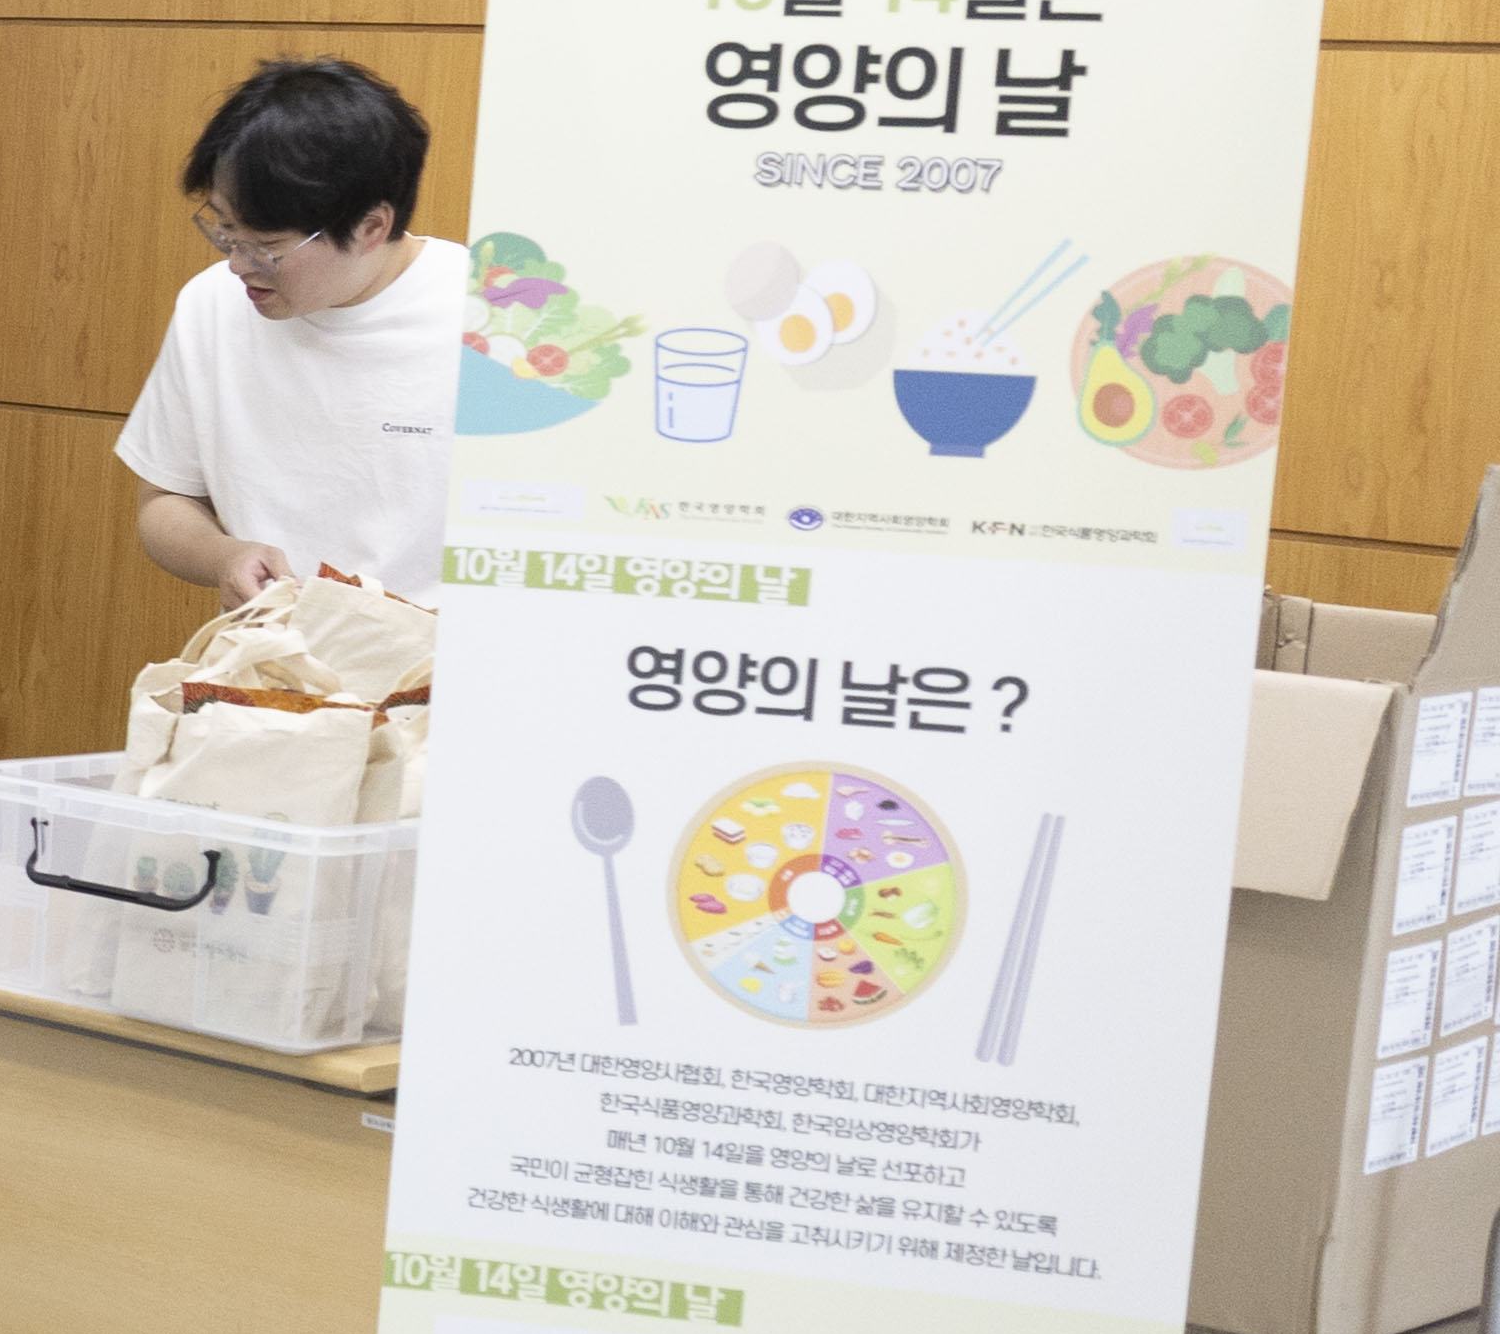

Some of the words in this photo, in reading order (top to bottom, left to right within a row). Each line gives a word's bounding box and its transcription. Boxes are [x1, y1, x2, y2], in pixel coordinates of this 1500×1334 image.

[703, 40, 965, 135] 영양의
[993, 46, 1087, 138] 날
[755, 151, 883, 191] SINCE
[896, 155, 1002, 194] 2007
[832, 511, 950, 529] 대한지역사회영양학회
[450, 546, 527, 588] 10월
[538, 550, 613, 595] 14일
[621, 556, 739, 604] 영양의
[752, 563, 796, 610] 날
[625, 646, 817, 723] 영양의
[839, 662, 973, 734] 날은
[991, 674, 1029, 734] ?
[509, 1047, 576, 1072] 2007년
[581, 1053, 725, 1088] 대한영양사협회,
[731, 1067, 858, 1102] 한국영양학회,
[864, 1082, 1080, 1127] 대한지역사회영양학회,
[600, 1091, 787, 1132] 한국식품영양과학회,
[792, 1112, 982, 1152] 한국임상영양학회가
[607, 1129, 647, 1153] 매년
[653, 1136, 695, 1159] 10월
[701, 1141, 764, 1165] 14일을
[770, 1146, 830, 1173] 영양의
[836, 1153, 876, 1177] 날로
[883, 1160, 966, 1188] 선포하고
[510, 1155, 569, 1180] 국민이
[573, 1161, 653, 1190] 균형잡힌
[658, 1172, 738, 1201] 식생활을
[743, 1182, 783, 1205] 통해
[789, 1185, 849, 1212] 건강한
[855, 1194, 896, 1218] 삶을
[901, 1198, 965, 1226] 유지할
[969, 1208, 990, 1228] 수
[994, 1210, 1058, 1237] 있도록
[467, 1186, 526, 1213] 건강한
[531, 1195, 610, 1222] 식생활에
[614, 1204, 653, 1227] 대해
[659, 1209, 720, 1234] 이해와
[724, 1216, 785, 1244] 관심을
[790, 1223, 893, 1255] 고취시키기
[898, 1235, 939, 1260] 위해
[945, 1241, 1008, 1268] 제정한
[1012, 1250, 1102, 1280] 날입니다.
[387, 1253, 461, 1294] 10월
[475, 1257, 549, 1303] 14일
[557, 1268, 672, 1316] 영양의
[684, 1278, 728, 1325] 날
